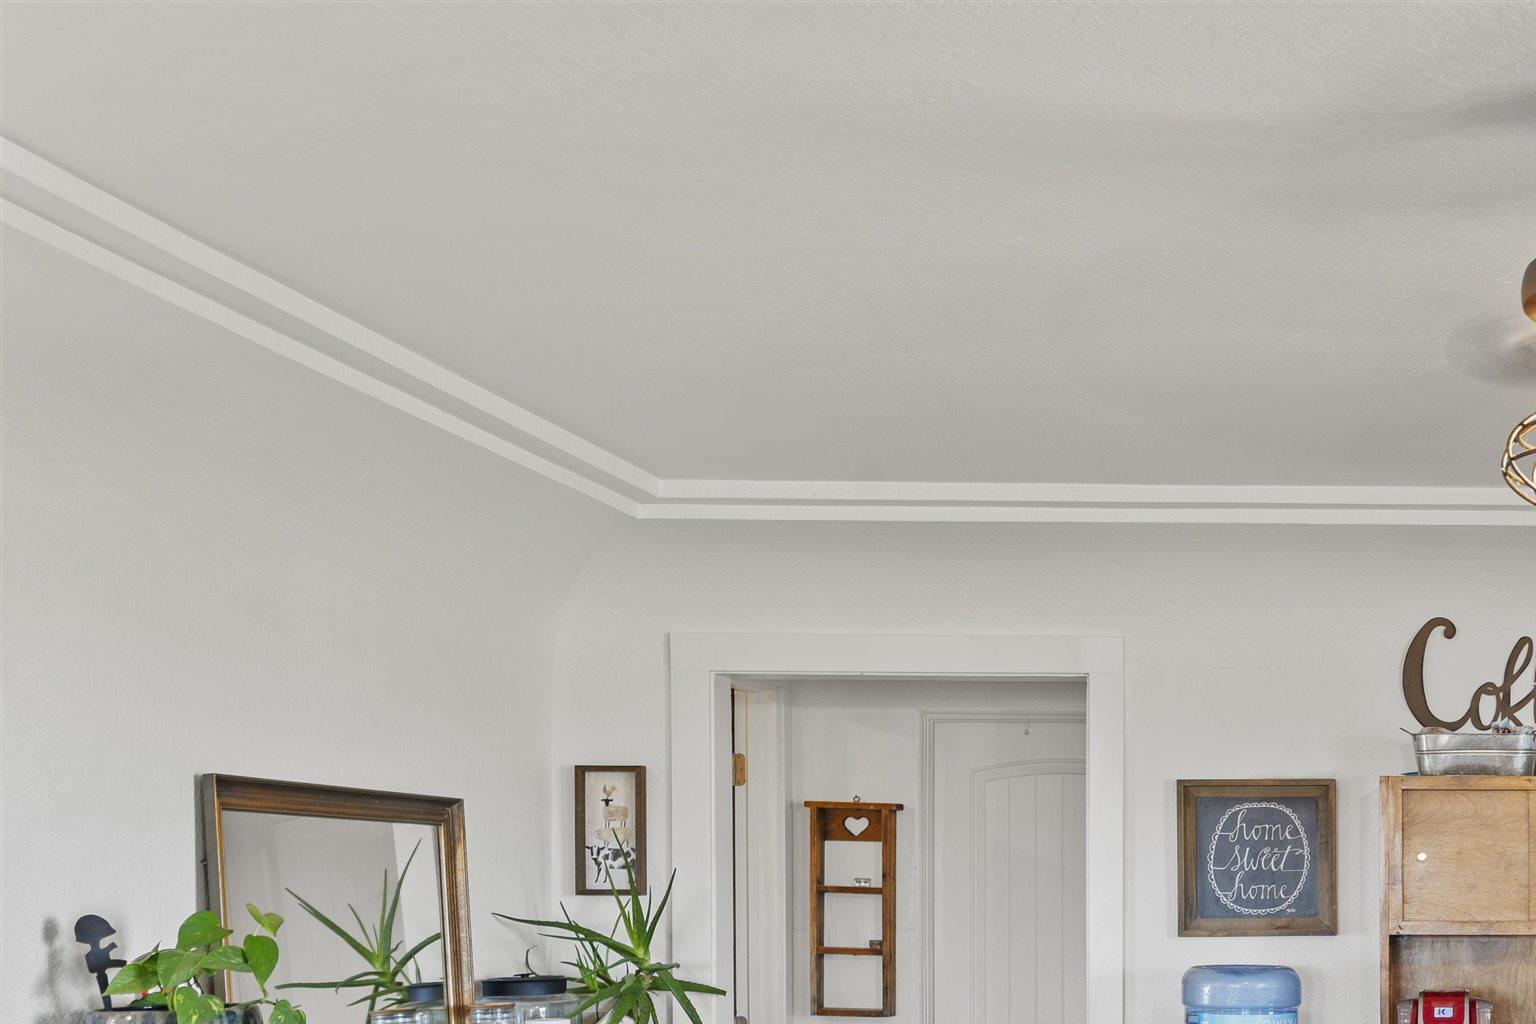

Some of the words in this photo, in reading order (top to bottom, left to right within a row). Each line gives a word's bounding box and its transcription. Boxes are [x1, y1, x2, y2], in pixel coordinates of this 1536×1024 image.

[1228, 809, 1300, 842] home
[1227, 845, 1301, 872] sweet
[1228, 871, 1293, 900] home
